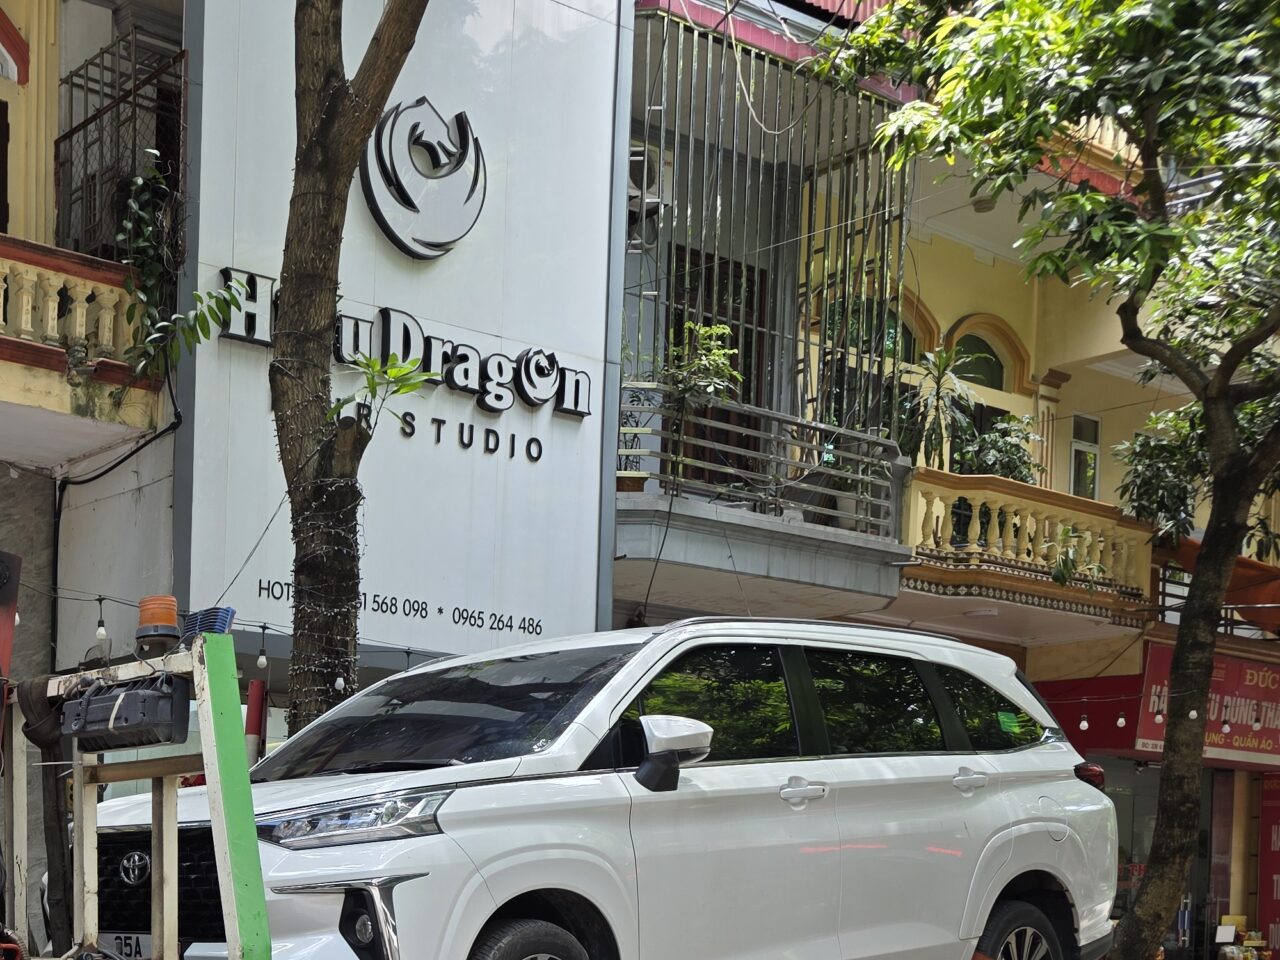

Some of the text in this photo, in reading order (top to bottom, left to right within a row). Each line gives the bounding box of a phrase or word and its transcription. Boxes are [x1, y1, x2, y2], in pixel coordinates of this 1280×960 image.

[400, 411, 543, 463] STUDIO
[371, 594, 398, 615] 568
[402, 598, 428, 619] 098
[452, 607, 485, 628] 0965
[489, 613, 514, 632] 264
[518, 617, 543, 636] 486
